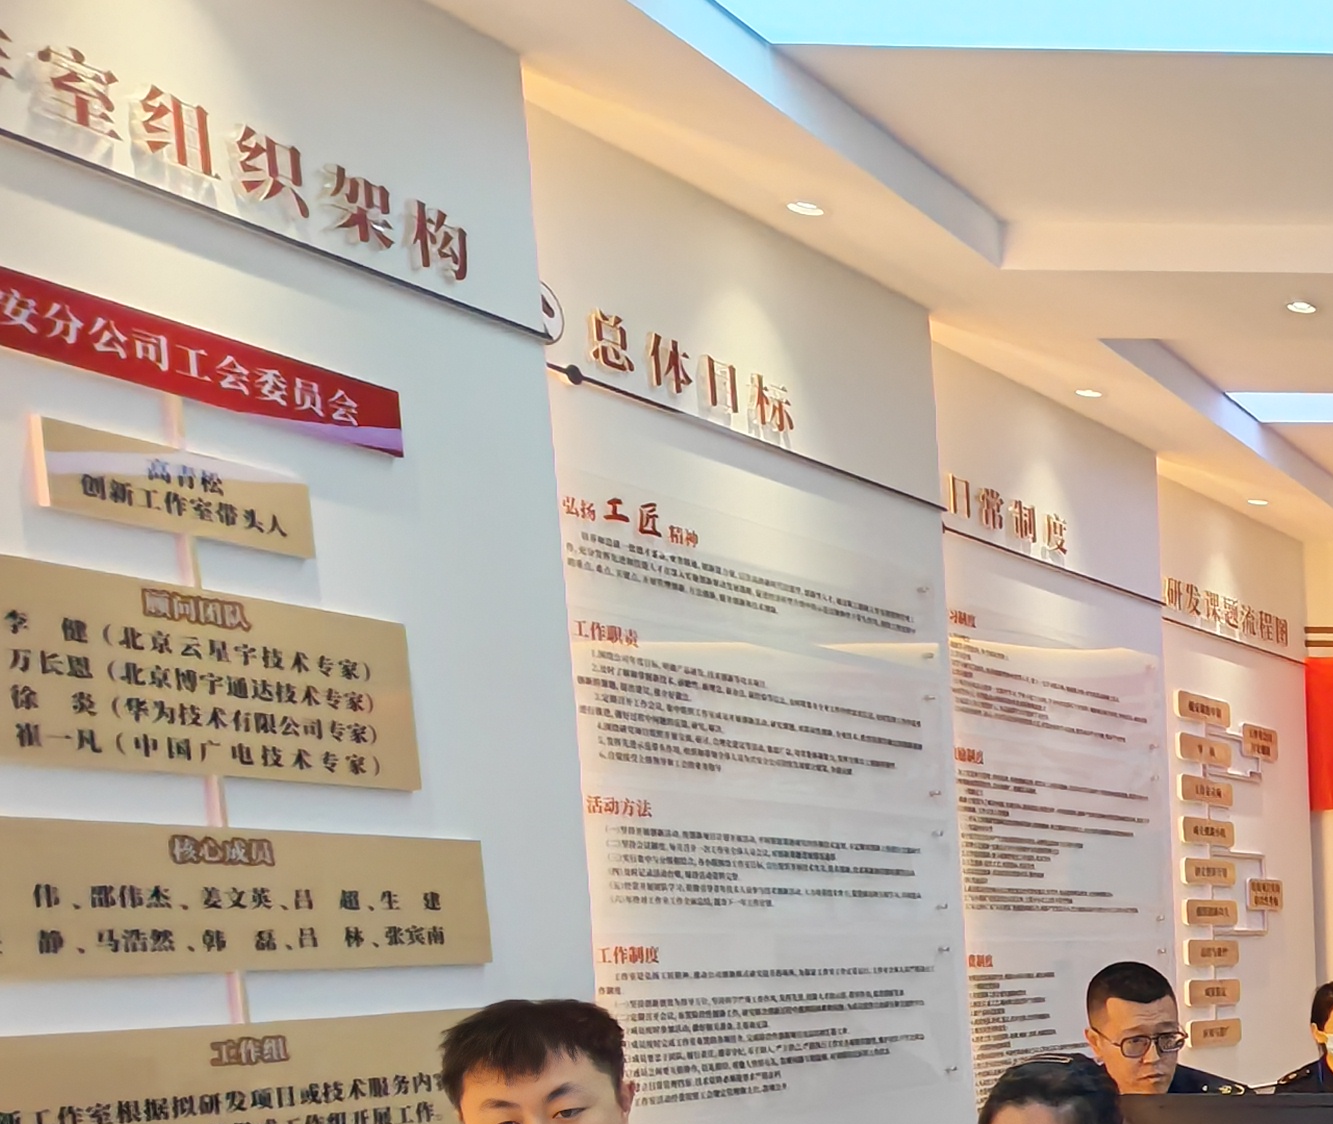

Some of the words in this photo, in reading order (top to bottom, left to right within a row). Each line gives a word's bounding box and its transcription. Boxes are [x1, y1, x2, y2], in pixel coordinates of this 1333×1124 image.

[592, 308, 794, 432] 总体目标
[81, 473, 289, 538] 创新工作室带头人
[949, 473, 1067, 555] 日常制度
[141, 587, 253, 632] 顾问团队
[1164, 577, 1289, 647] 研发课题流程图
[573, 619, 639, 648] 工作职责
[586, 795, 653, 818] 活动方法
[168, 834, 276, 867] 核心成员
[597, 946, 660, 965] 工作制度
[210, 1036, 290, 1067] 工作组
